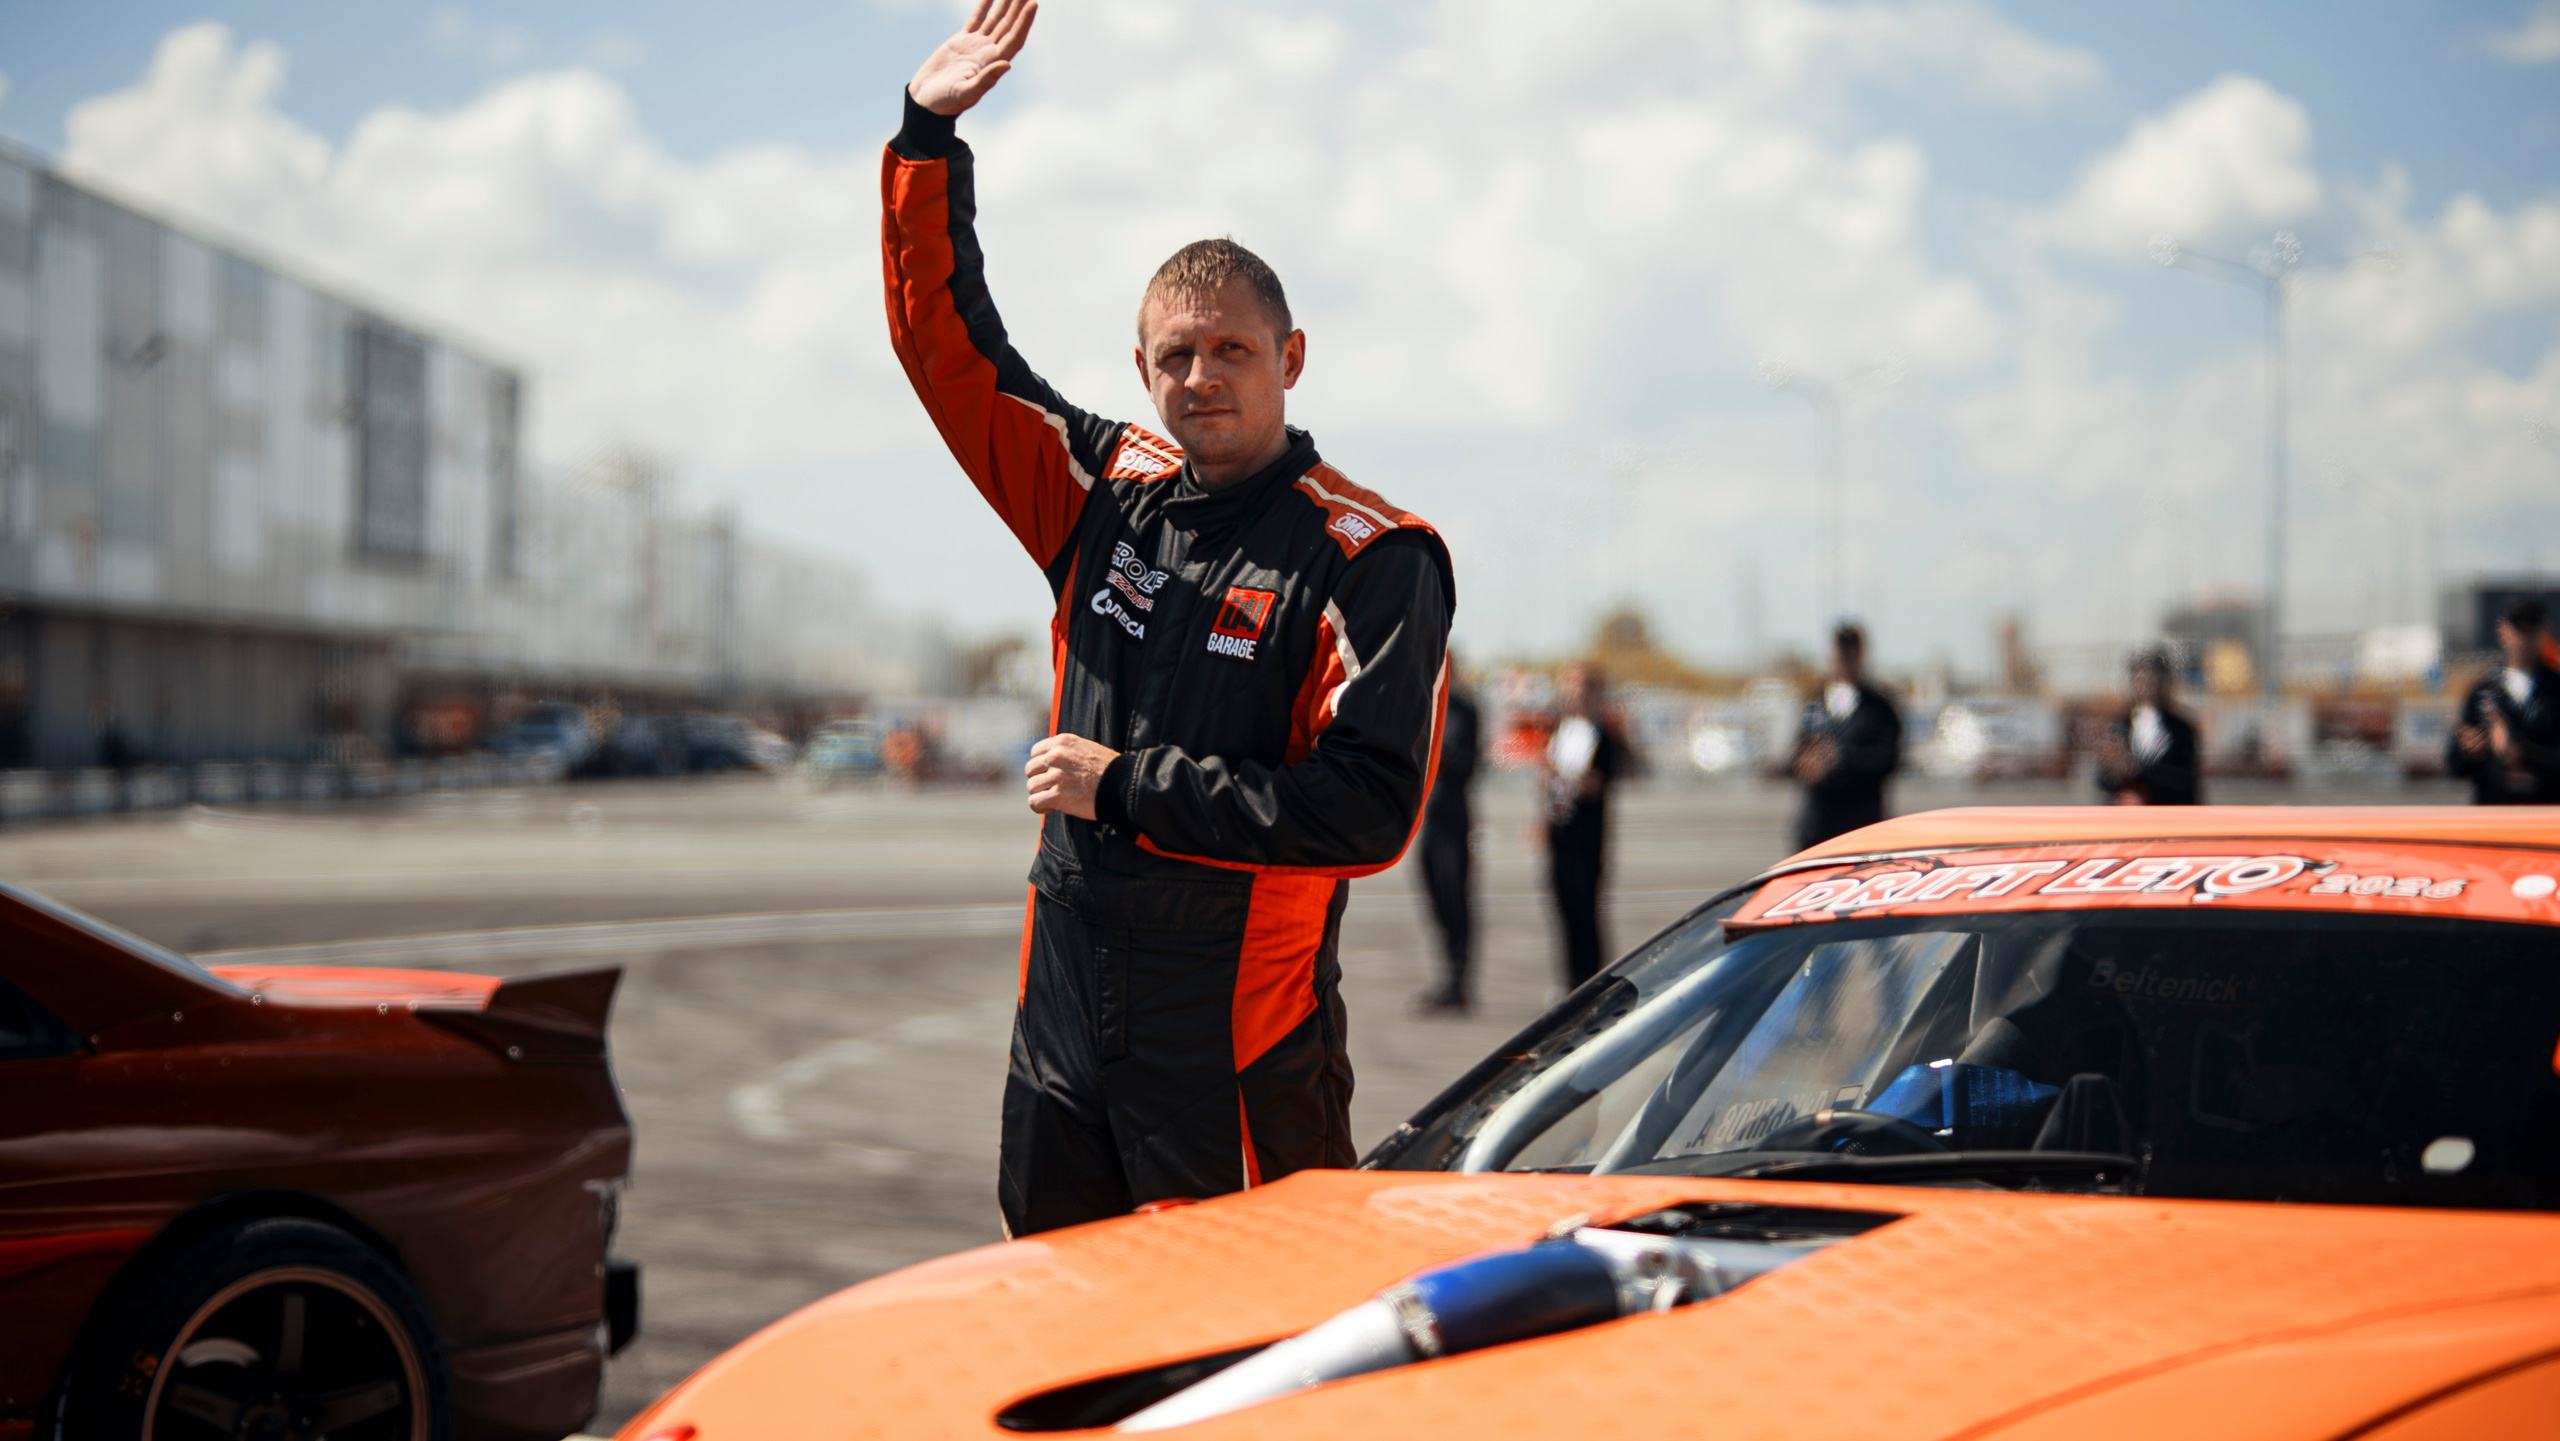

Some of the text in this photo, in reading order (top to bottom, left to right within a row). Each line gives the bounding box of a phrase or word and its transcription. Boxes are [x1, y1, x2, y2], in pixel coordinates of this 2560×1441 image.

[1118, 450, 1165, 474] OMP
[1335, 515, 1372, 540] OMP
[1206, 632, 1258, 661] GARAGE
[1762, 854, 2468, 918] DRIFT LETO 2026
[2086, 959, 2243, 1002] Beltenick
